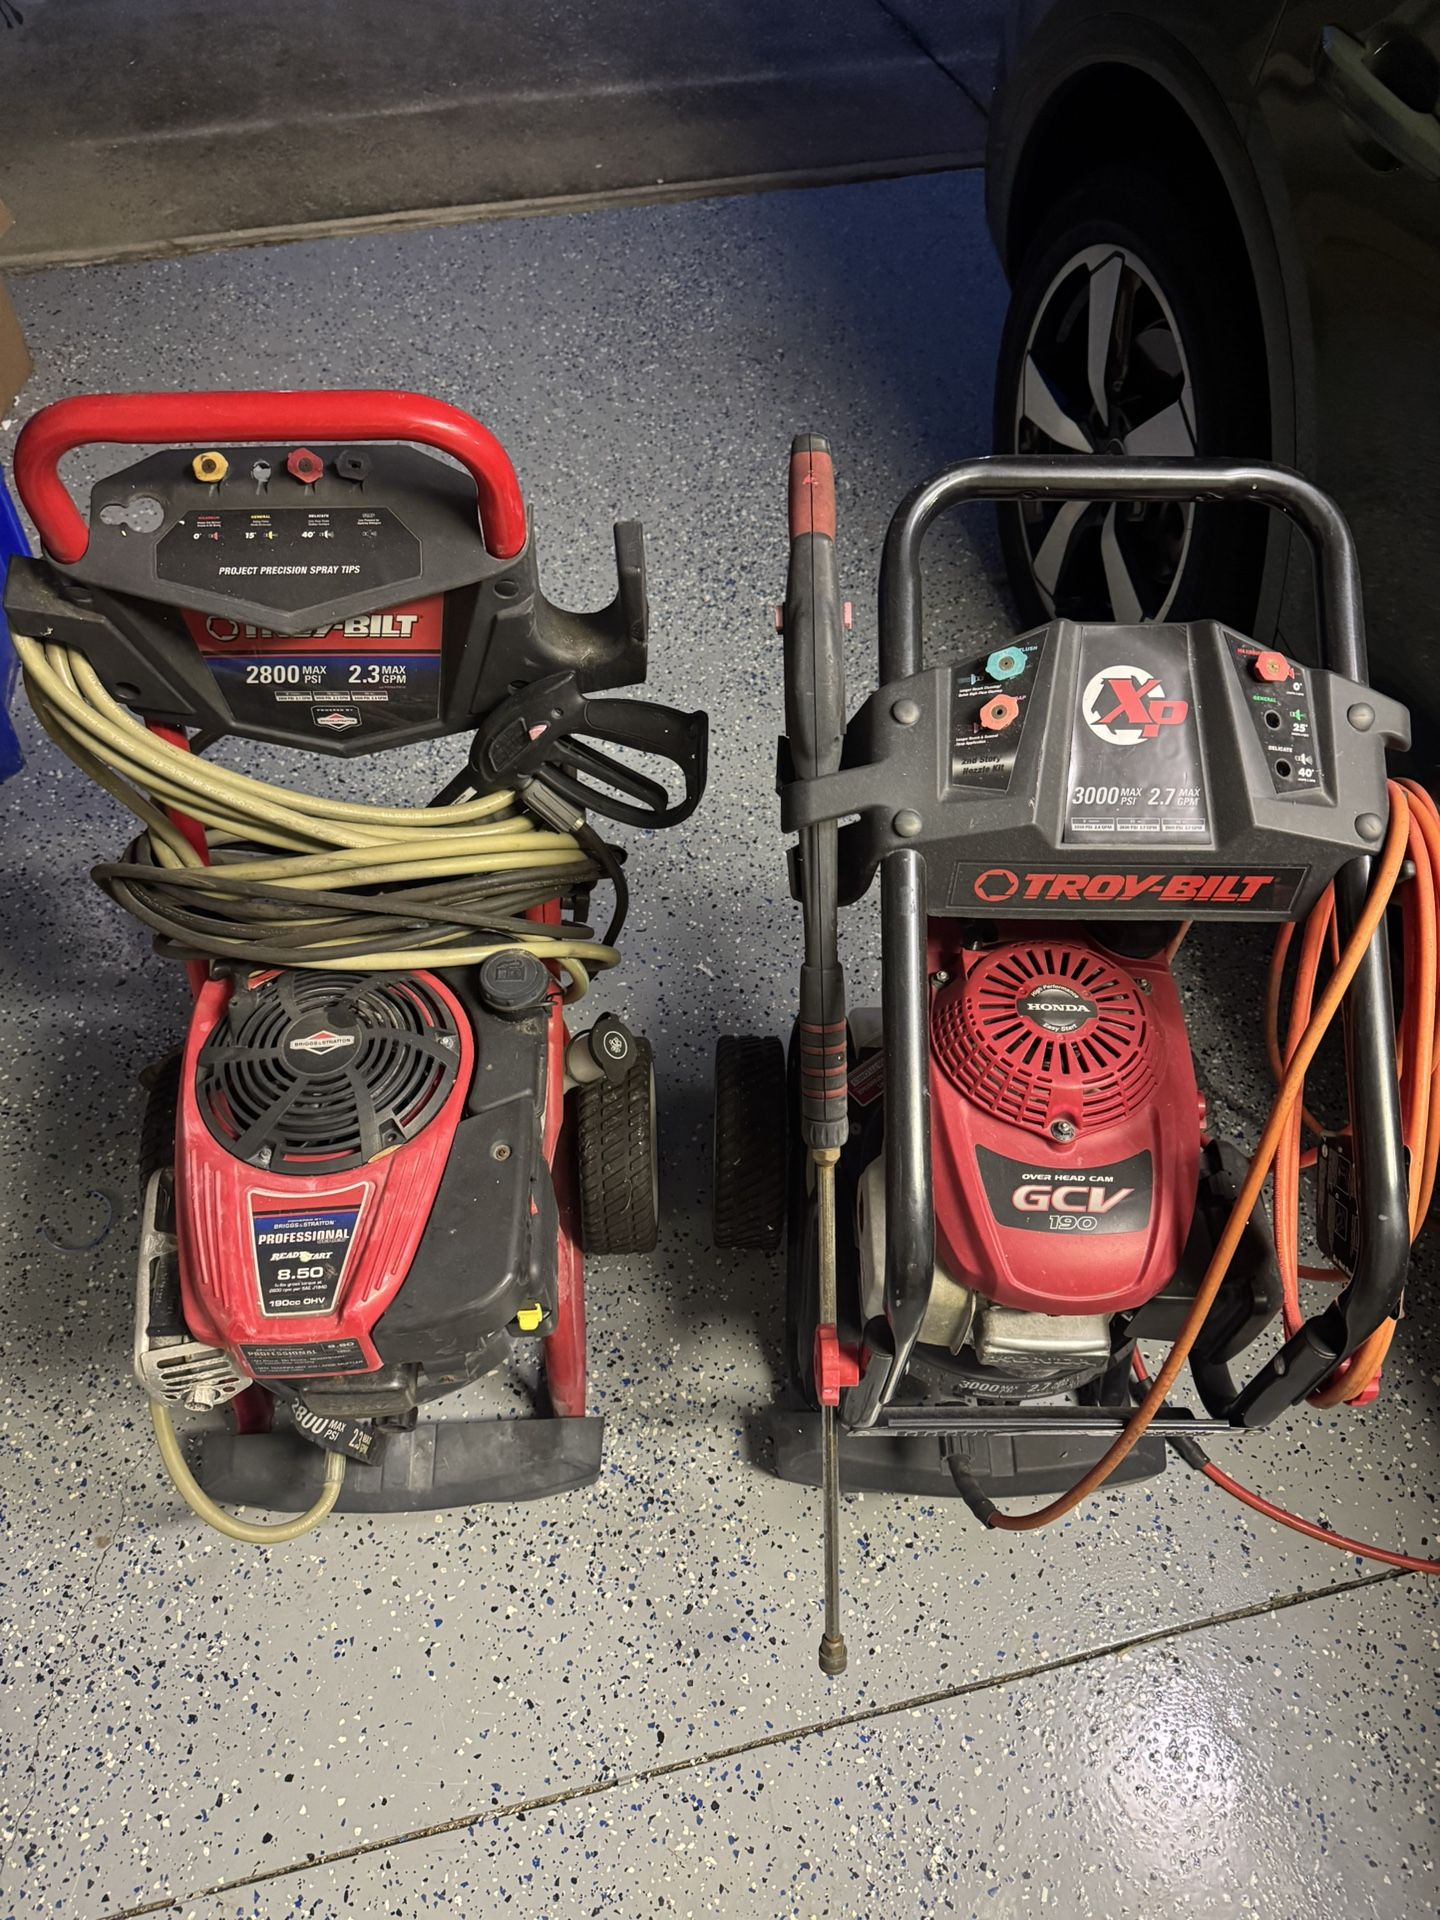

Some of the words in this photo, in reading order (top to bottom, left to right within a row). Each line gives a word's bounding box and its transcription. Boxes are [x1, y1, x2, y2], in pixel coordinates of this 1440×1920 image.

[219, 566, 258, 575] PROJECT
[260, 566, 308, 575] PRECISION
[309, 565, 339, 575] SPRAY
[342, 565, 361, 574] TIPS
[246, 615, 418, 638] -BILT
[246, 665, 299, 684] 2800
[302, 666, 327, 675] MAX
[349, 665, 380, 684] 2.3
[382, 666, 406, 675] MAX
[304, 675, 321, 684] PSI
[382, 675, 406, 684] GPM
[1252, 695, 1277, 703] GENERAL
[1268, 745, 1293, 753] DELICATE
[961, 757, 977, 765] 2nd
[979, 755, 1001, 764] Story
[962, 766, 991, 776] Nozzle
[993, 764, 1005, 772] Kit
[1072, 786, 1120, 805] 3000
[1120, 787, 1142, 797] MAX
[1148, 787, 1176, 806] 2.7
[1178, 788, 1200, 797] MAX
[1120, 797, 1136, 806] PSI
[1177, 797, 1199, 807] GPM
[1022, 873, 1275, 903] TROY-BILT
[1026, 1003, 1091, 1013] HONDA
[1042, 1022, 1060, 1032] Easy
[1060, 1023, 1078, 1032] Start
[1021, 1173, 1052, 1181] OVER
[1054, 1174, 1086, 1182] HEAD
[1088, 1175, 1114, 1183] CAM
[1011, 1184, 1136, 1214] GCV
[1049, 1215, 1098, 1231] 190
[258, 1229, 350, 1245] PROFESSIONAL
[270, 1251, 334, 1262] READTART
[277, 1266, 324, 1281] 8.50
[303, 1297, 326, 1305] OHV
[958, 1380, 1000, 1393] 3000
[1026, 1382, 1053, 1393] 2.7
[291, 1397, 330, 1434] 2800
[328, 1419, 347, 1433] MAX
[323, 1429, 340, 1442] PSI
